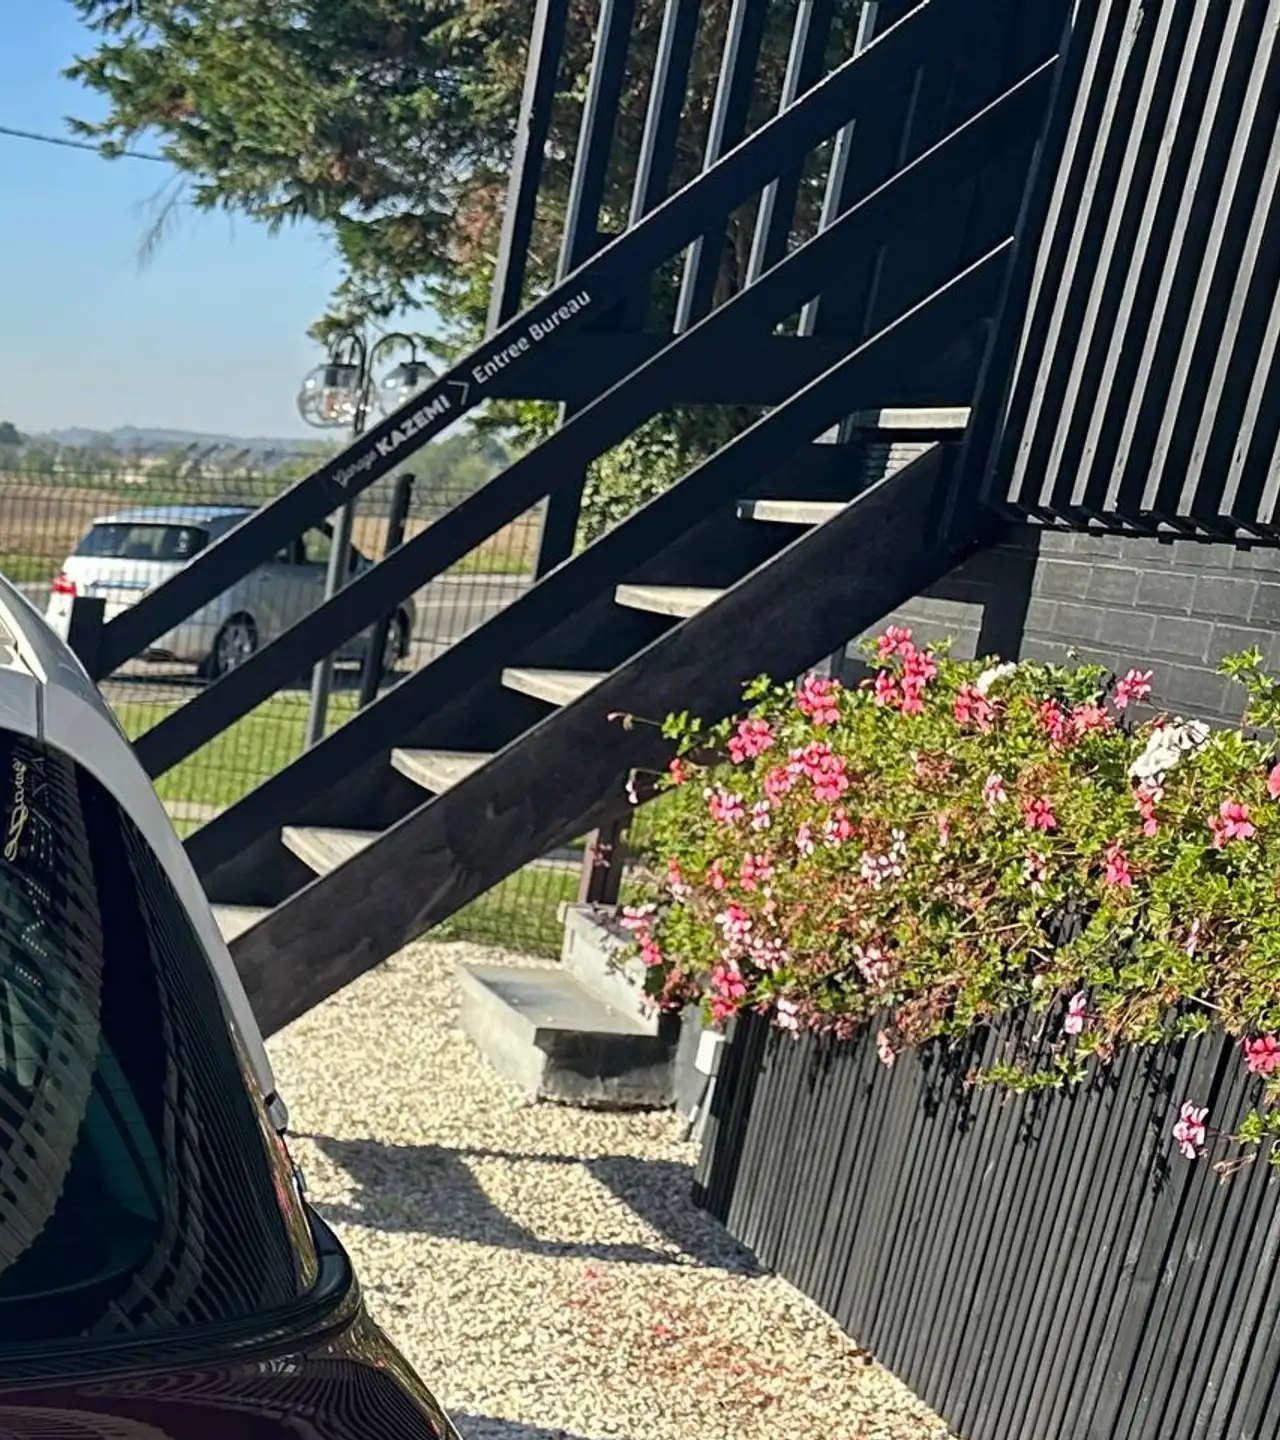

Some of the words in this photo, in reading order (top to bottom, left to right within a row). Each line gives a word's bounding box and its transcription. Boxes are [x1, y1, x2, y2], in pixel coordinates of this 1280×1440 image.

[375, 393, 452, 456] KAZEMI
[472, 337, 530, 385] Entree
[528, 290, 592, 342] Bureau
